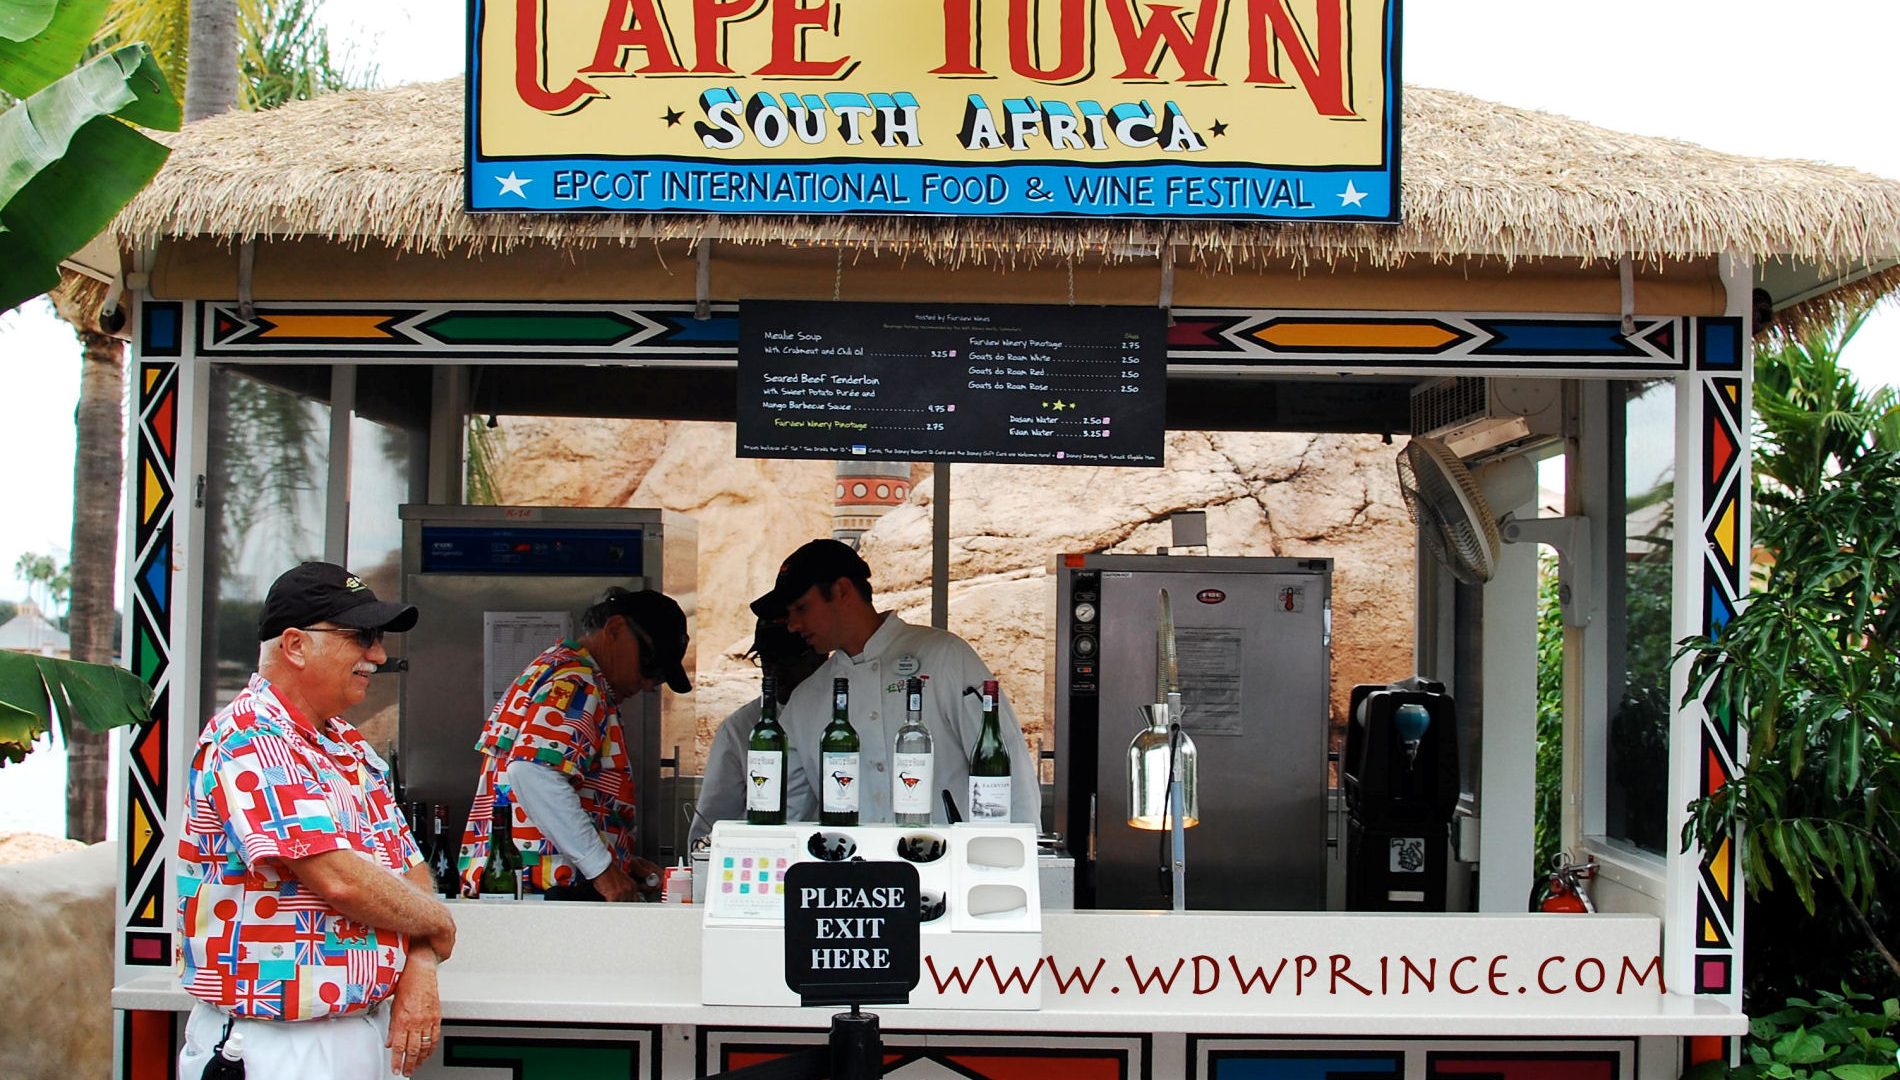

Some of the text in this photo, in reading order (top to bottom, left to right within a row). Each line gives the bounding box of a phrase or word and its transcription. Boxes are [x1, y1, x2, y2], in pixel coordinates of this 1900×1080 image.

[694, 86, 1208, 151] SOUTH AFRICA
[554, 169, 1315, 210] EPCOT INTERNATIONAL FOOD & WINE FESTIVAL
[764, 329, 823, 343] Mealie Soup
[968, 336, 1141, 351] Fairview Winery Pinotage 2.75
[782, 345, 819, 355] Crabmeat
[820, 346, 835, 356] and
[931, 349, 948, 358] 3.25
[968, 351, 1140, 364] Goats do Roam White 2.50
[763, 372, 881, 386] Seared Beef Tenderloin
[967, 365, 1140, 379] Goats do Roam Red 2.50
[780, 387, 807, 397] Sweet
[808, 388, 834, 397] Potato
[861, 389, 876, 398] and
[967, 380, 993, 390] Goats
[993, 381, 1005, 390] do
[1005, 381, 1027, 391] Roam
[1120, 384, 1140, 394] 2.50
[762, 401, 788, 412] Mango
[788, 400, 826, 410] Barbecue
[826, 402, 852, 411] Sauce
[774, 417, 945, 432] Fairview Winery Pinotage 2.75
[1009, 414, 1102, 425] Dasani Water 2.50
[1030, 428, 1055, 437] Water
[1082, 429, 1102, 438] 3.25
[800, 887, 906, 909] PLEASE
[815, 918, 885, 939] EXIT
[810, 948, 891, 969] HERE
